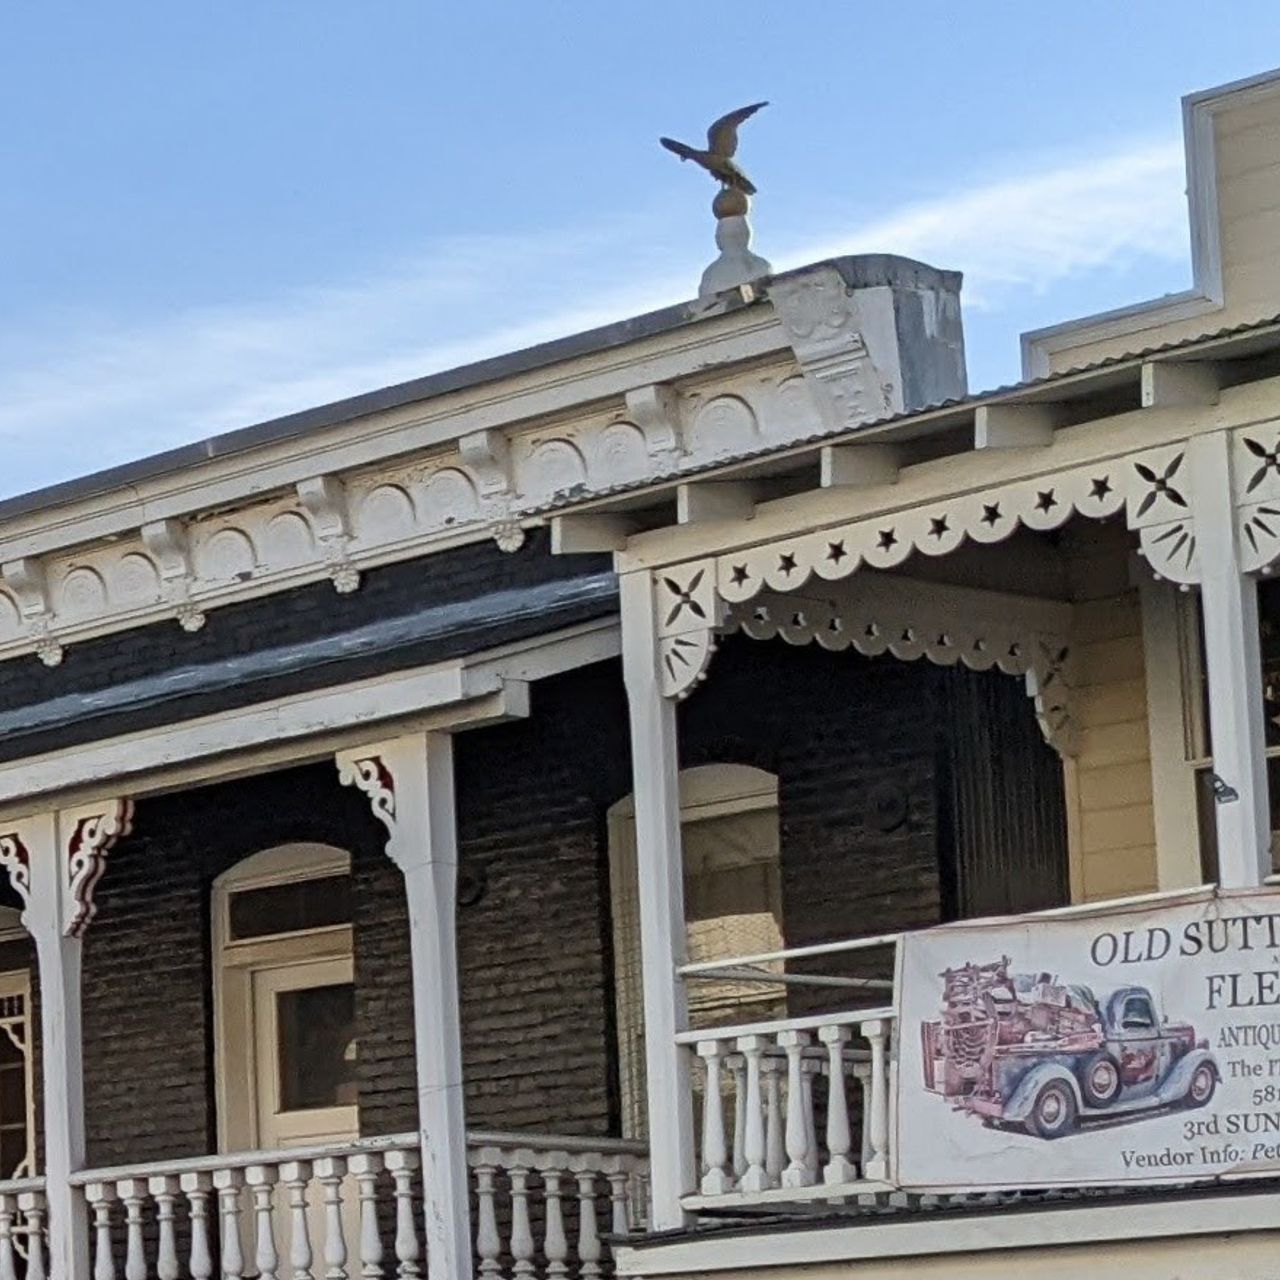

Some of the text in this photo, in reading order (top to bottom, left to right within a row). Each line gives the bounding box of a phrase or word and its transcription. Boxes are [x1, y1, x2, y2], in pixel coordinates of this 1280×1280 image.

[1091, 914, 1280, 966] OLD SUTT
[1206, 970, 1280, 1010] FLE
[1217, 1023, 1280, 1051] ANTIQU
[1227, 1060, 1263, 1077] The
[1183, 1112, 1280, 1141] 3rd SUN
[1121, 1148, 1194, 1168] Vendor
[1200, 1143, 1244, 1164] Info:
